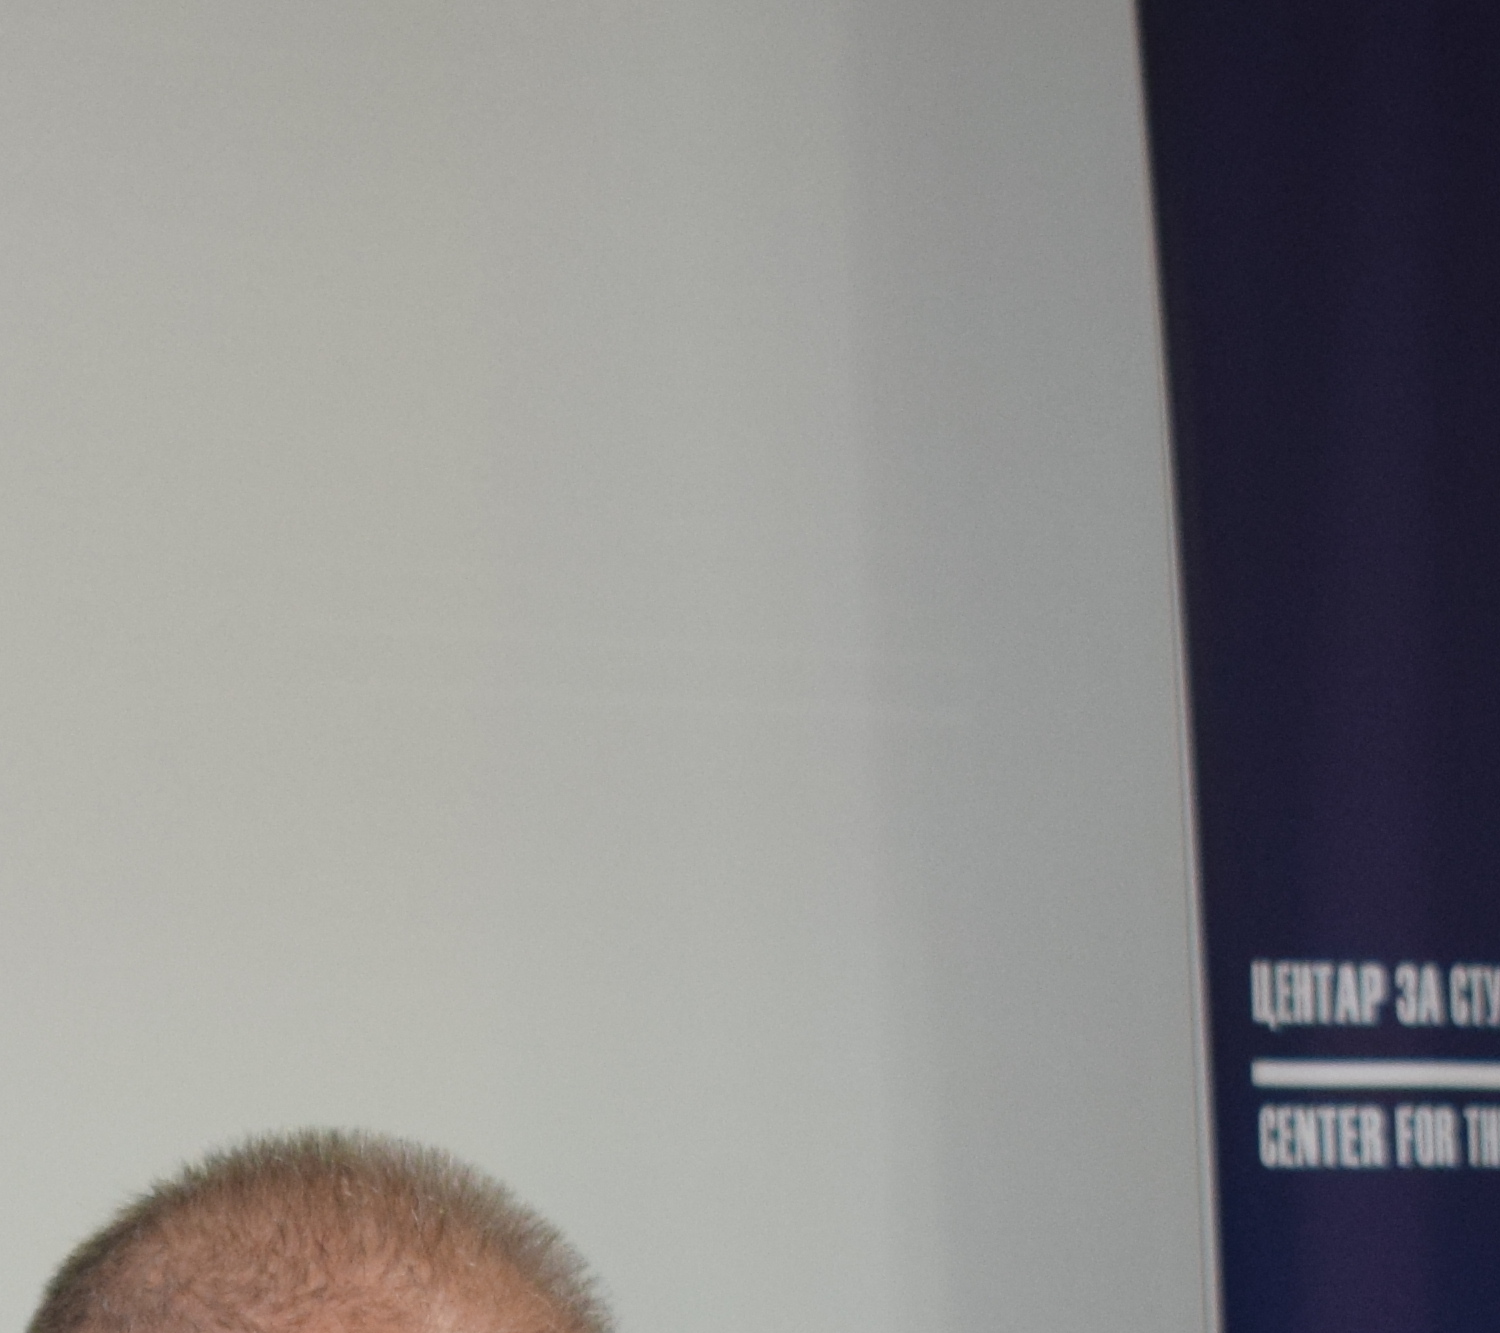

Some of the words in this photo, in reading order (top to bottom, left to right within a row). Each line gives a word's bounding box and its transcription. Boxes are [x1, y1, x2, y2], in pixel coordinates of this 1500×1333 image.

[1251, 961, 1388, 1031] ЦЕНТАР
[1394, 962, 1446, 1028] ЗА
[1258, 1105, 1387, 1169] CENTER
[1394, 1105, 1459, 1169] FOR
